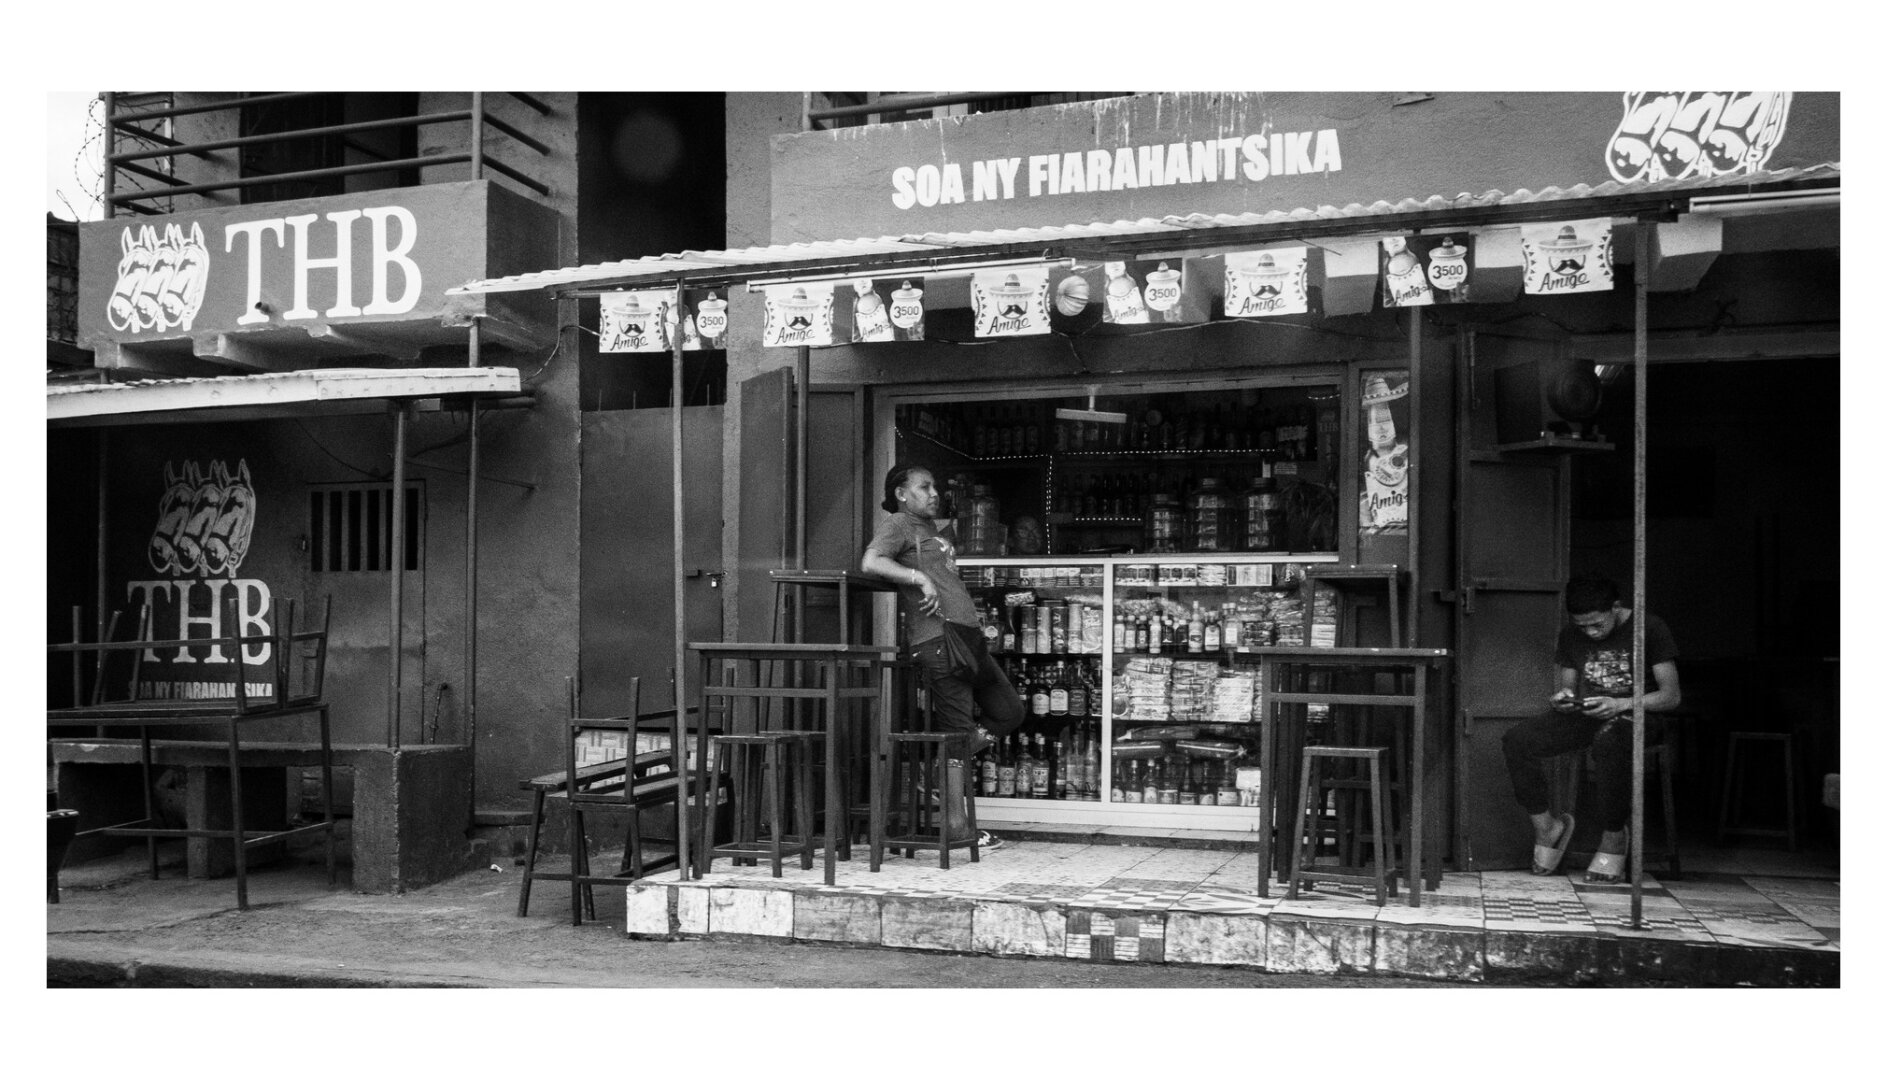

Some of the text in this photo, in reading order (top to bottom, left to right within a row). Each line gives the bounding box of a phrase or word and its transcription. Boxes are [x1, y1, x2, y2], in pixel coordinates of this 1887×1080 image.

[891, 128, 1342, 210] SOA NY FIARAHANTSIKA
[224, 205, 422, 326] THB
[1432, 264, 1464, 280] 3500
[1537, 272, 1591, 293] Amigo
[1148, 287, 1177, 302] 3500
[893, 305, 920, 319] 3500
[1237, 296, 1287, 316] Amigo
[700, 316, 725, 329] 3500
[986, 316, 1032, 335] Amigo
[609, 333, 649, 351] Amigo
[774, 327, 816, 345] Amigo
[127, 578, 272, 666] THB
[155, 681, 172, 699] NY
[173, 681, 273, 700] FIARAHANSIKA
